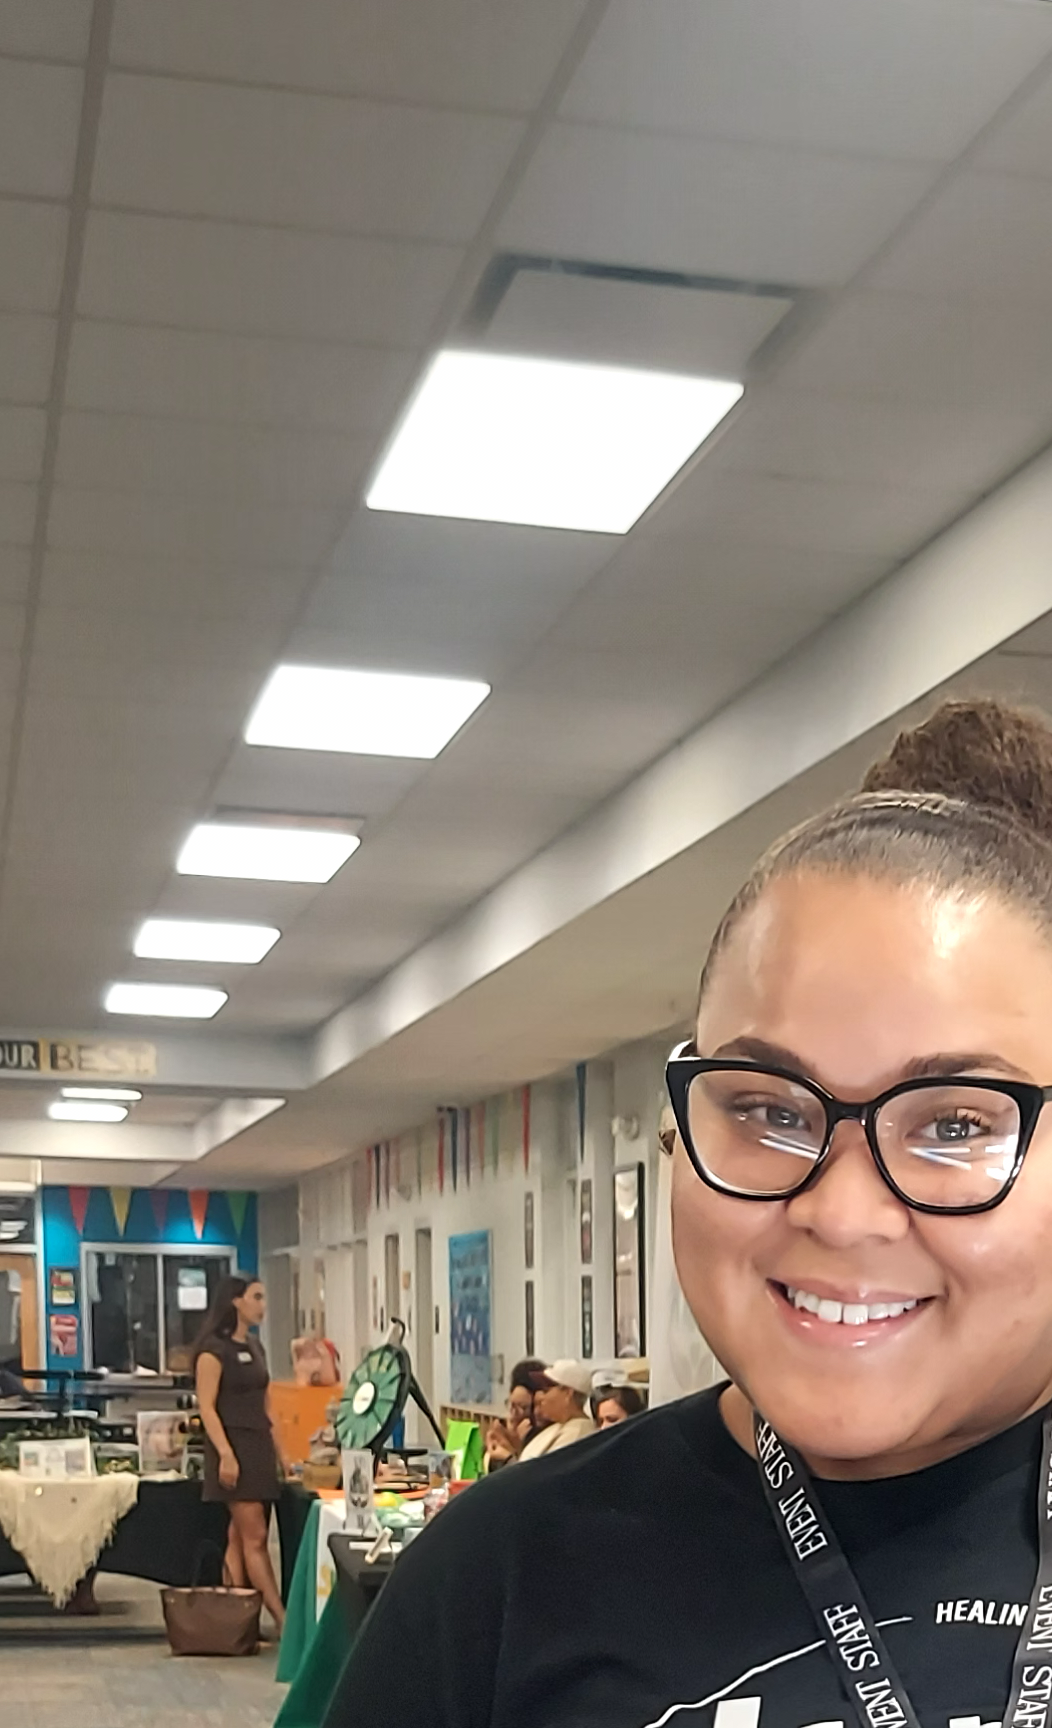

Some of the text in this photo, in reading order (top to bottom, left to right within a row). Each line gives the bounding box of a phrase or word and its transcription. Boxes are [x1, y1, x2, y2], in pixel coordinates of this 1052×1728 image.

[0, 1043, 37, 1068] UR
[778, 1486, 829, 1561] EVENT
[935, 1600, 1028, 1626] HEALIN
[822, 1604, 880, 1671] STAFF
